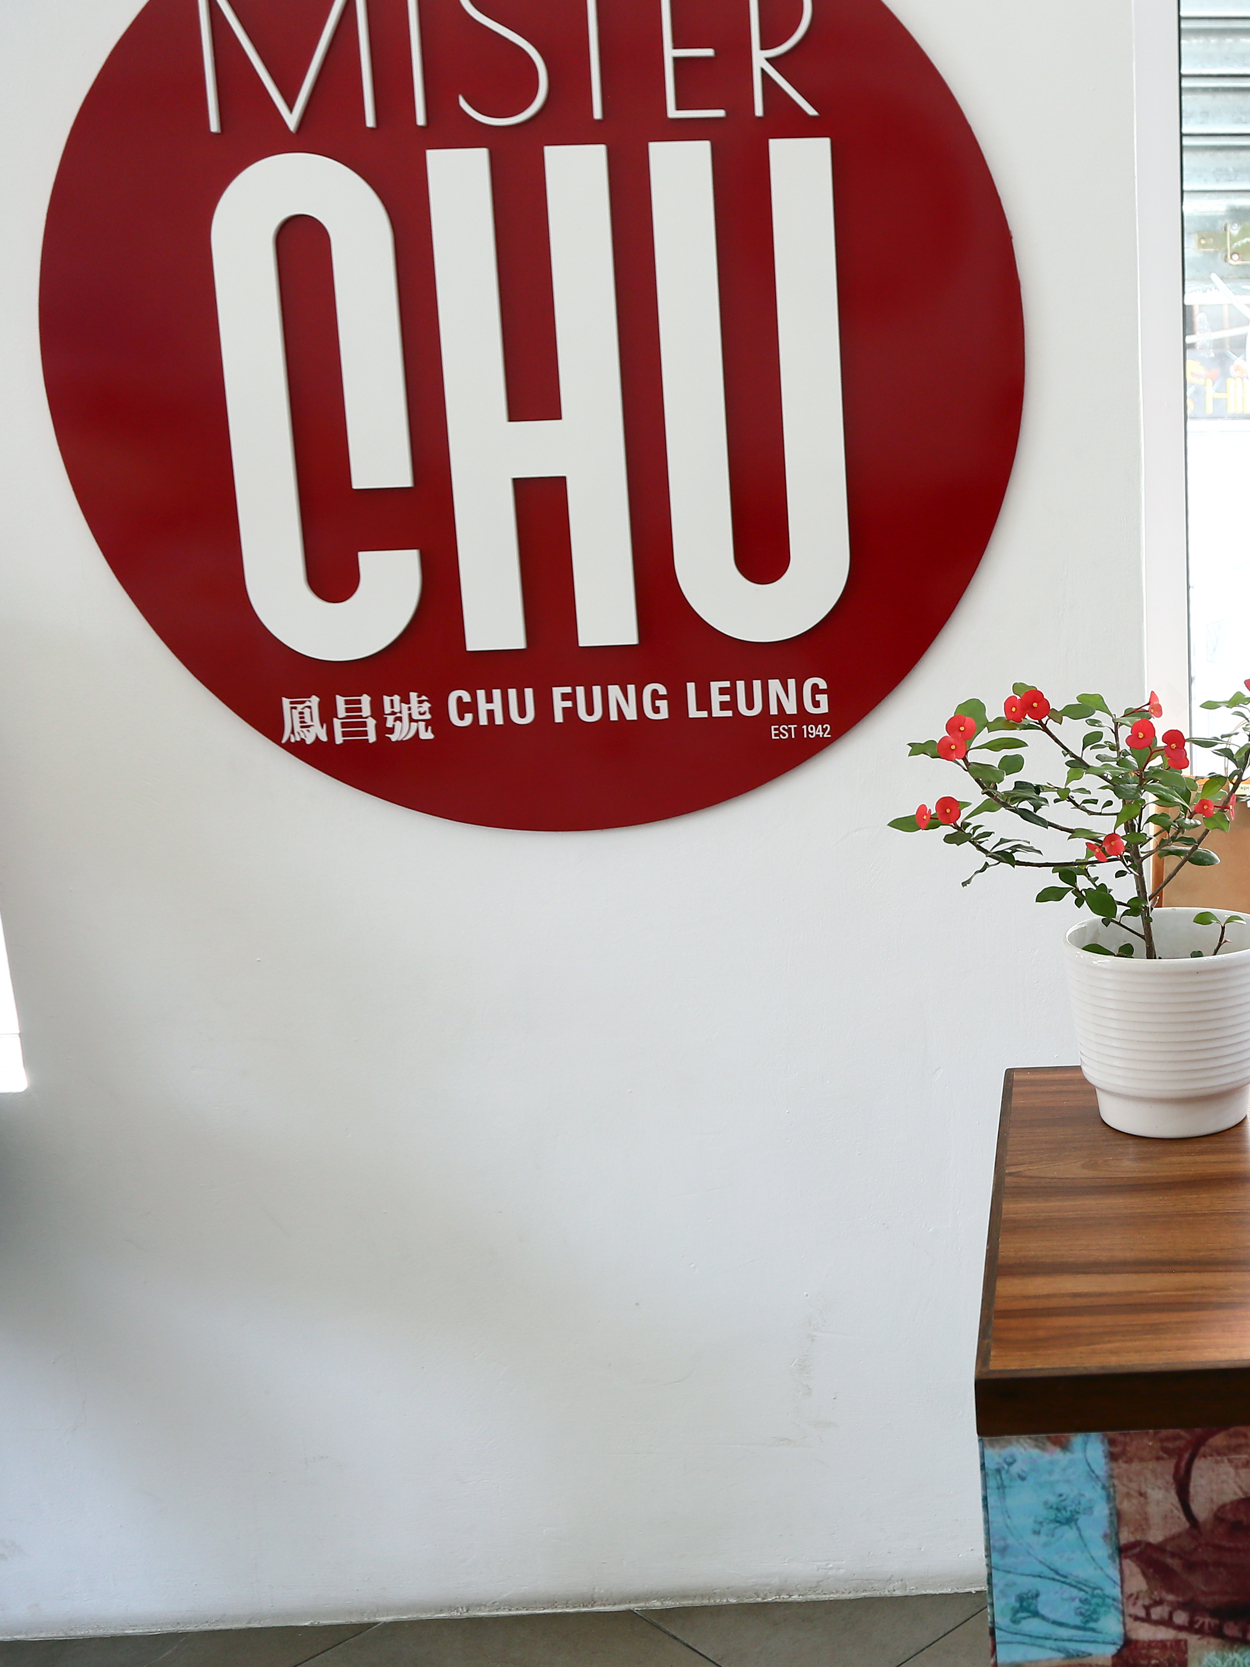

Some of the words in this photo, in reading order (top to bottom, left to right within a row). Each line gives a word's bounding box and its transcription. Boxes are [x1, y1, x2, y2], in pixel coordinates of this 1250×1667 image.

[210, 137, 851, 662] CHU
[281, 692, 435, 746] 鳳昌號
[447, 683, 537, 729] CHU
[554, 681, 670, 725] FUNG
[687, 676, 831, 719] LEUNG
[771, 724, 797, 742] EST
[800, 722, 832, 740] 1942
